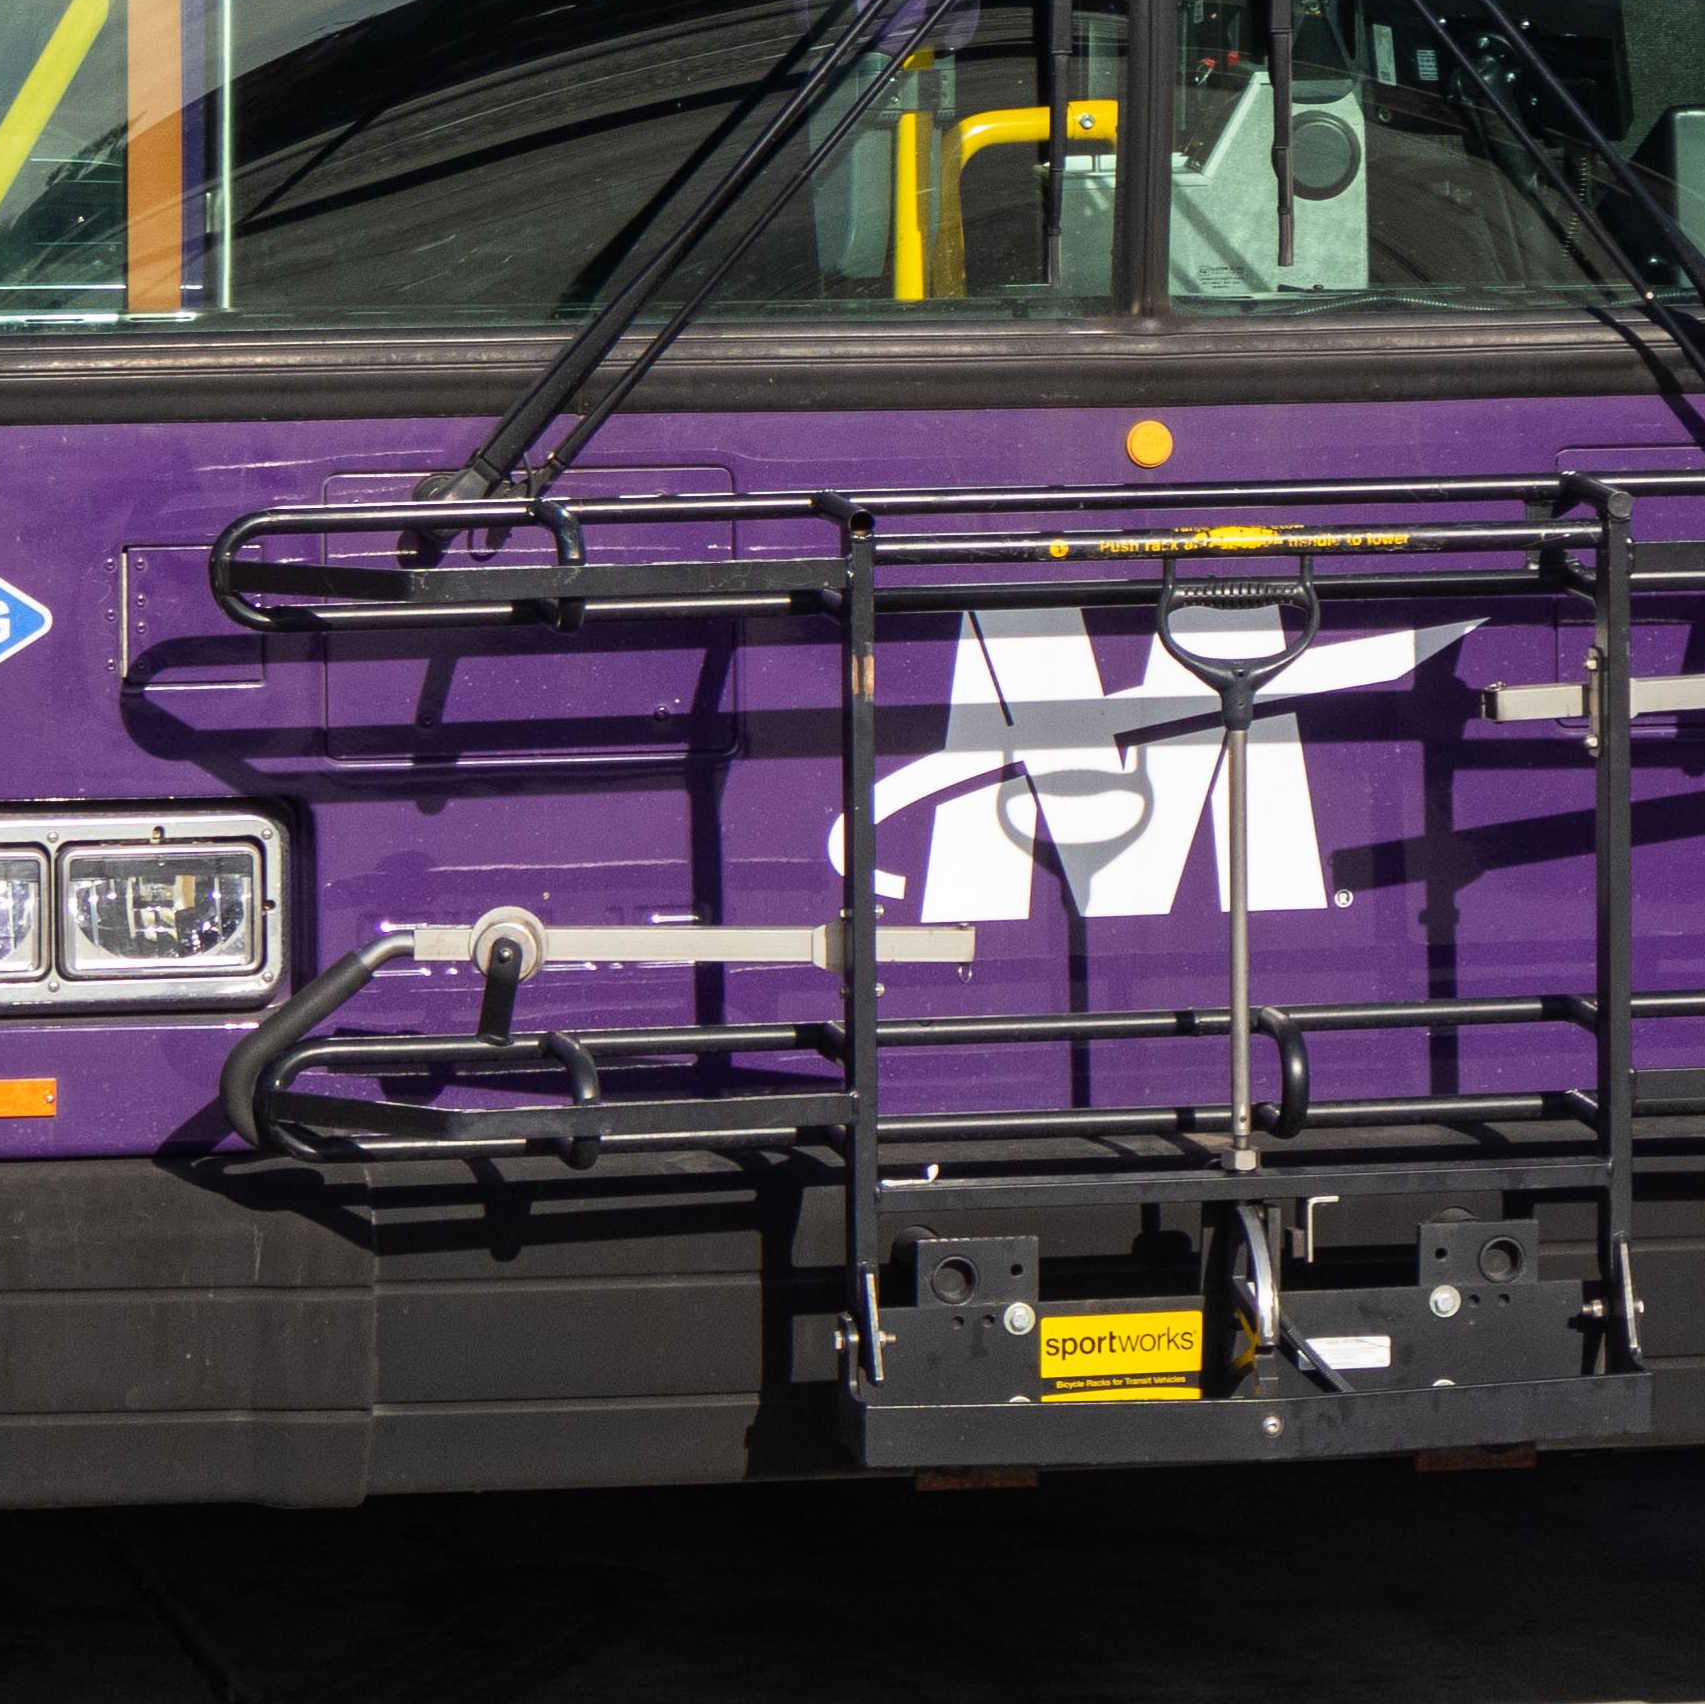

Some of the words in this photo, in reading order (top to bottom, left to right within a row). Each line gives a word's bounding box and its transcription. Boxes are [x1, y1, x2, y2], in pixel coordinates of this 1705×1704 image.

[1099, 539, 1139, 553] Push
[1346, 533, 1362, 546] to
[1365, 532, 1409, 545] lower
[1045, 1326, 1195, 1361] sportworks
[1056, 1380, 1085, 1390] Bicycle
[1112, 1378, 1124, 1386] for
[1124, 1376, 1152, 1385] Transit
